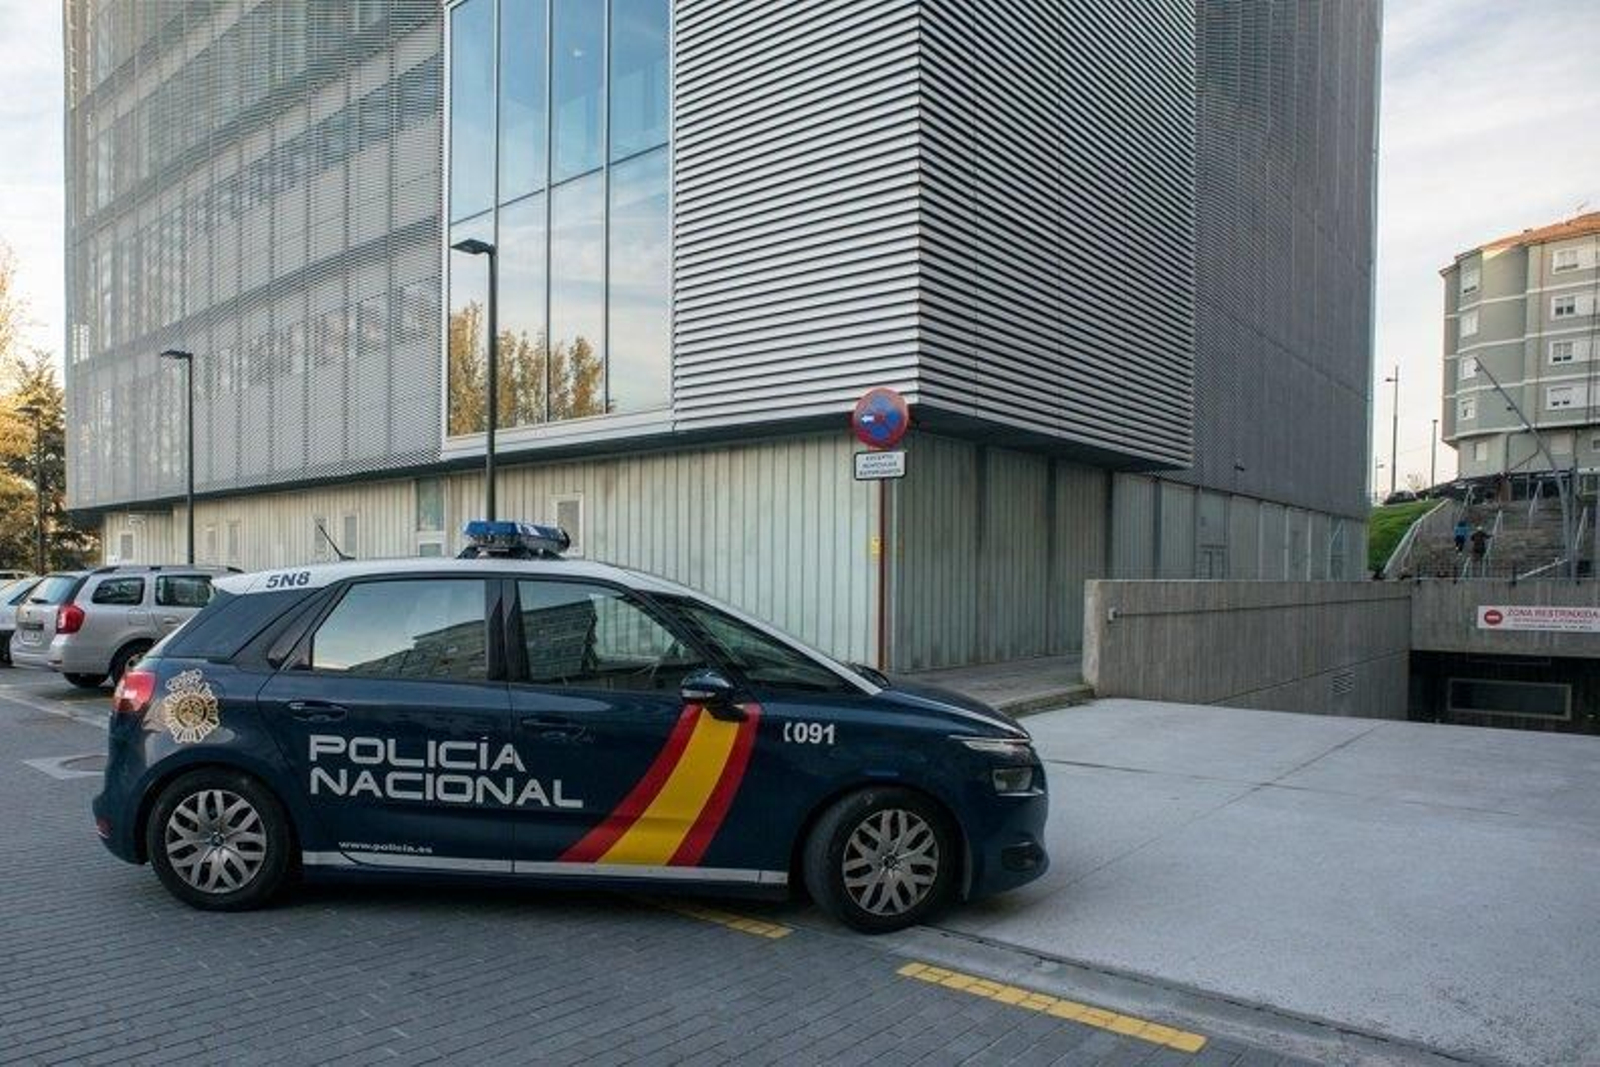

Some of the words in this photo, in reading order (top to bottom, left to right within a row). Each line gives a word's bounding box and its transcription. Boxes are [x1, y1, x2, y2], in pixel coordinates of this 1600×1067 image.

[265, 571, 311, 588] 5N8
[1507, 608, 1533, 616] ZONA
[793, 722, 834, 744] 091
[309, 735, 527, 772] POLICÍA
[309, 766, 584, 808] NACIONAL
